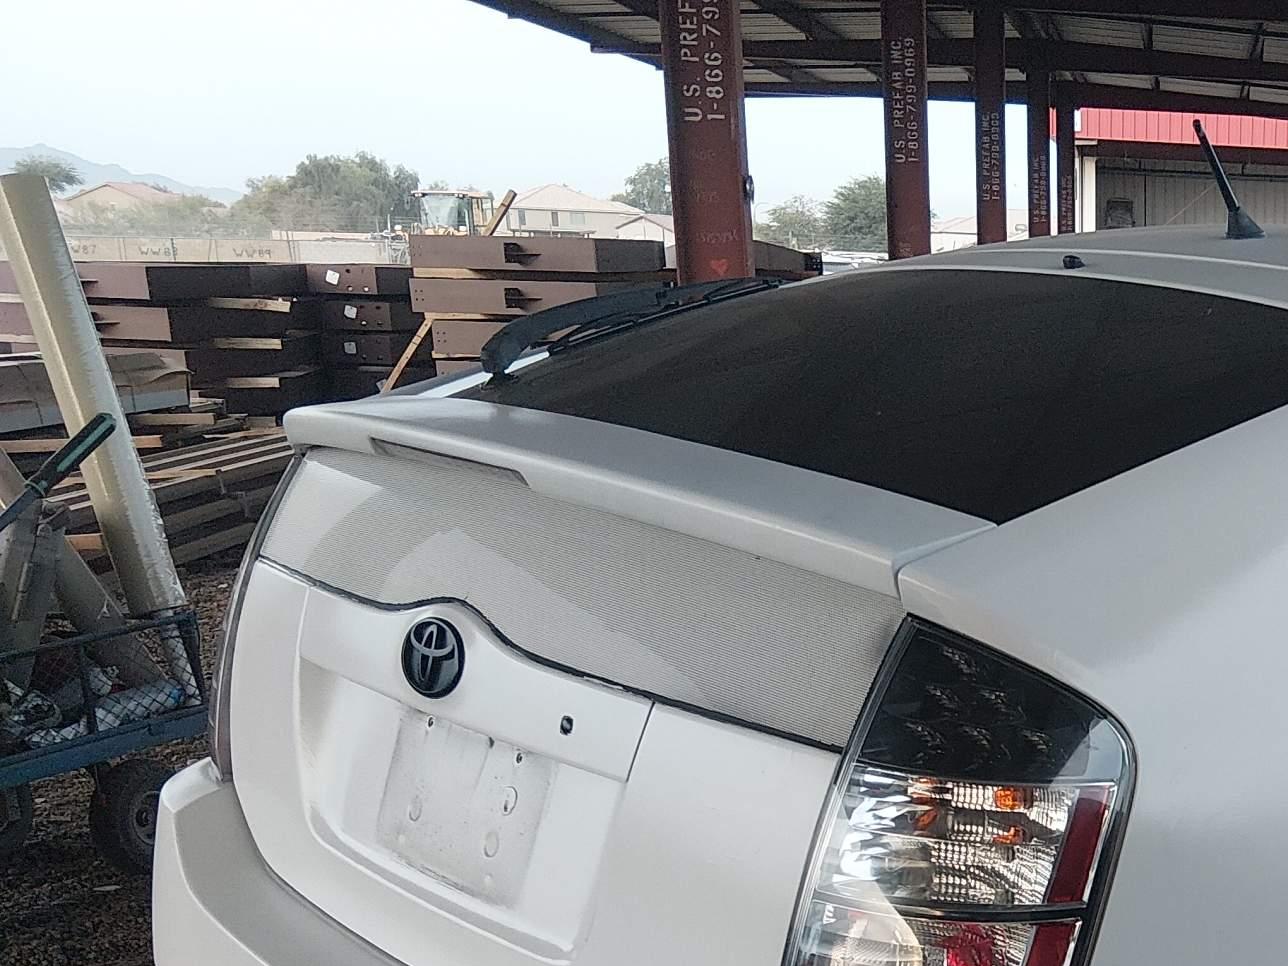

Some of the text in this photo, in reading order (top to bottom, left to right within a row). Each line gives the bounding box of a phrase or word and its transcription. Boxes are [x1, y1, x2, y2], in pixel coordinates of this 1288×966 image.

[682, 76, 703, 122] U.S.
[702, 0, 726, 120] 1-866-79
[890, 36, 906, 163] U.S. PREFAB INC.
[904, 37, 920, 161] 1-866-799-0969
